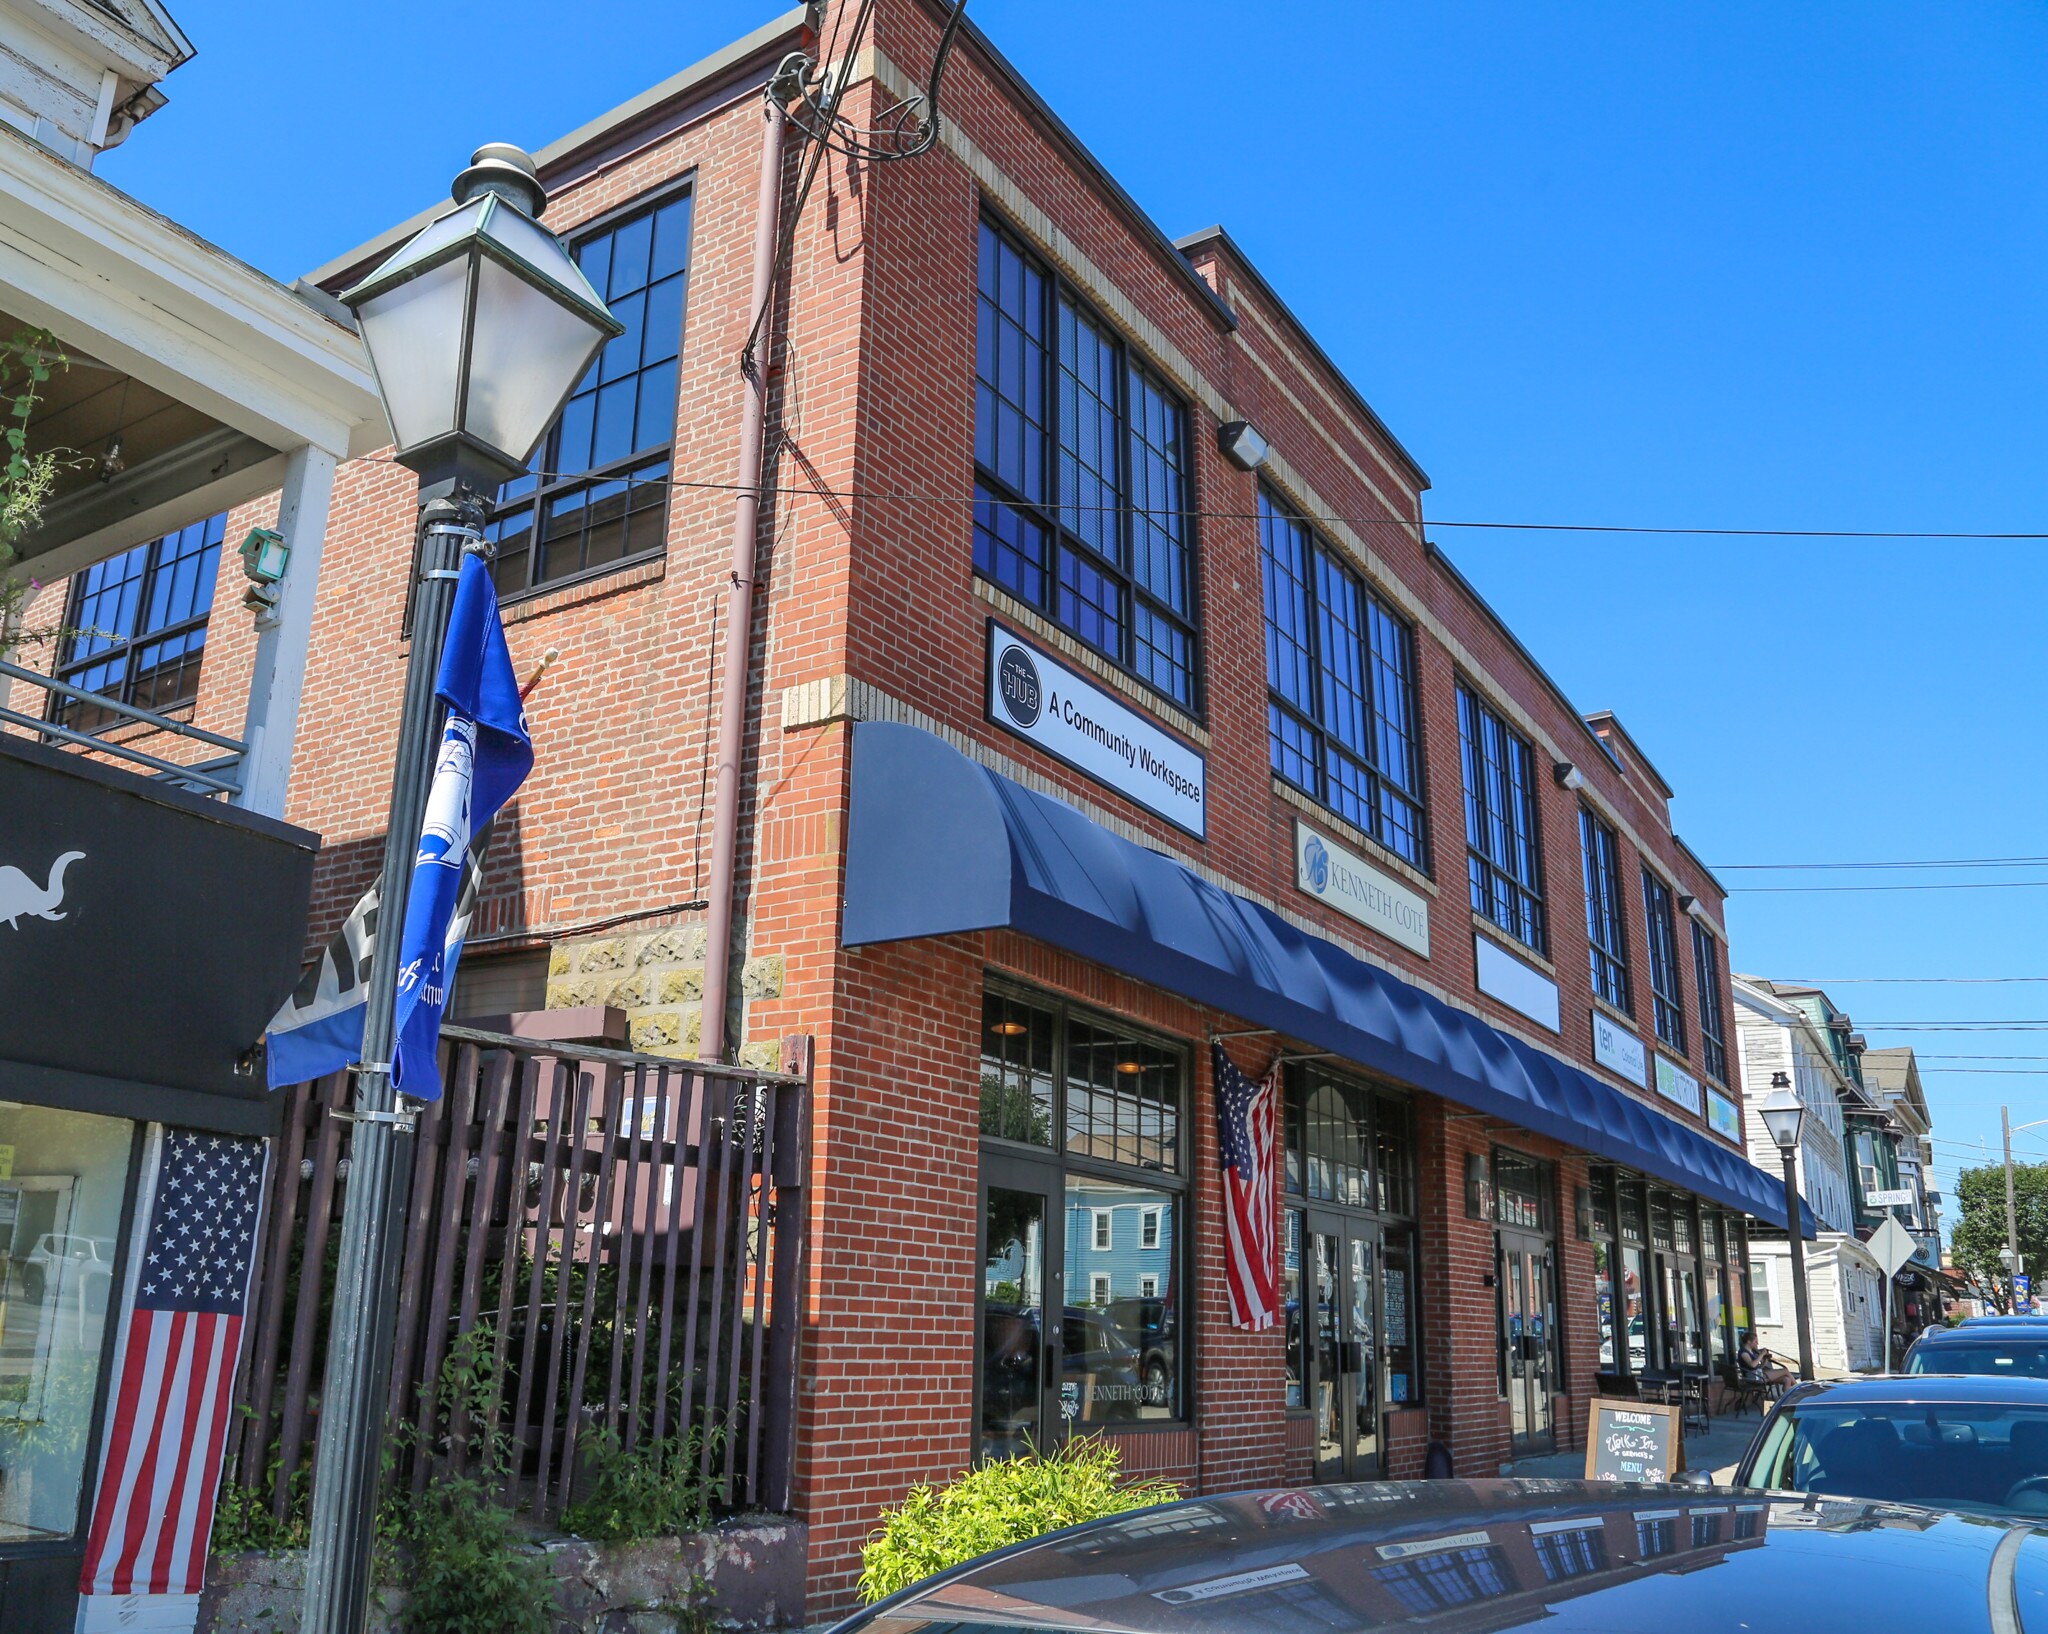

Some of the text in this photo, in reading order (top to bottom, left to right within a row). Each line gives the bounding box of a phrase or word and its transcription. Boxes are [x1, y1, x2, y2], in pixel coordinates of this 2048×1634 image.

[1015, 664, 1027, 678] THE
[1003, 670, 1038, 711] HUB
[1049, 692, 1200, 803] A Community Workspace
[1331, 861, 1393, 920] KENNETH
[1878, 1191, 1906, 1204] SPRING
[1614, 1411, 1652, 1425] WELCOME
[1620, 1461, 1643, 1474] MENU
